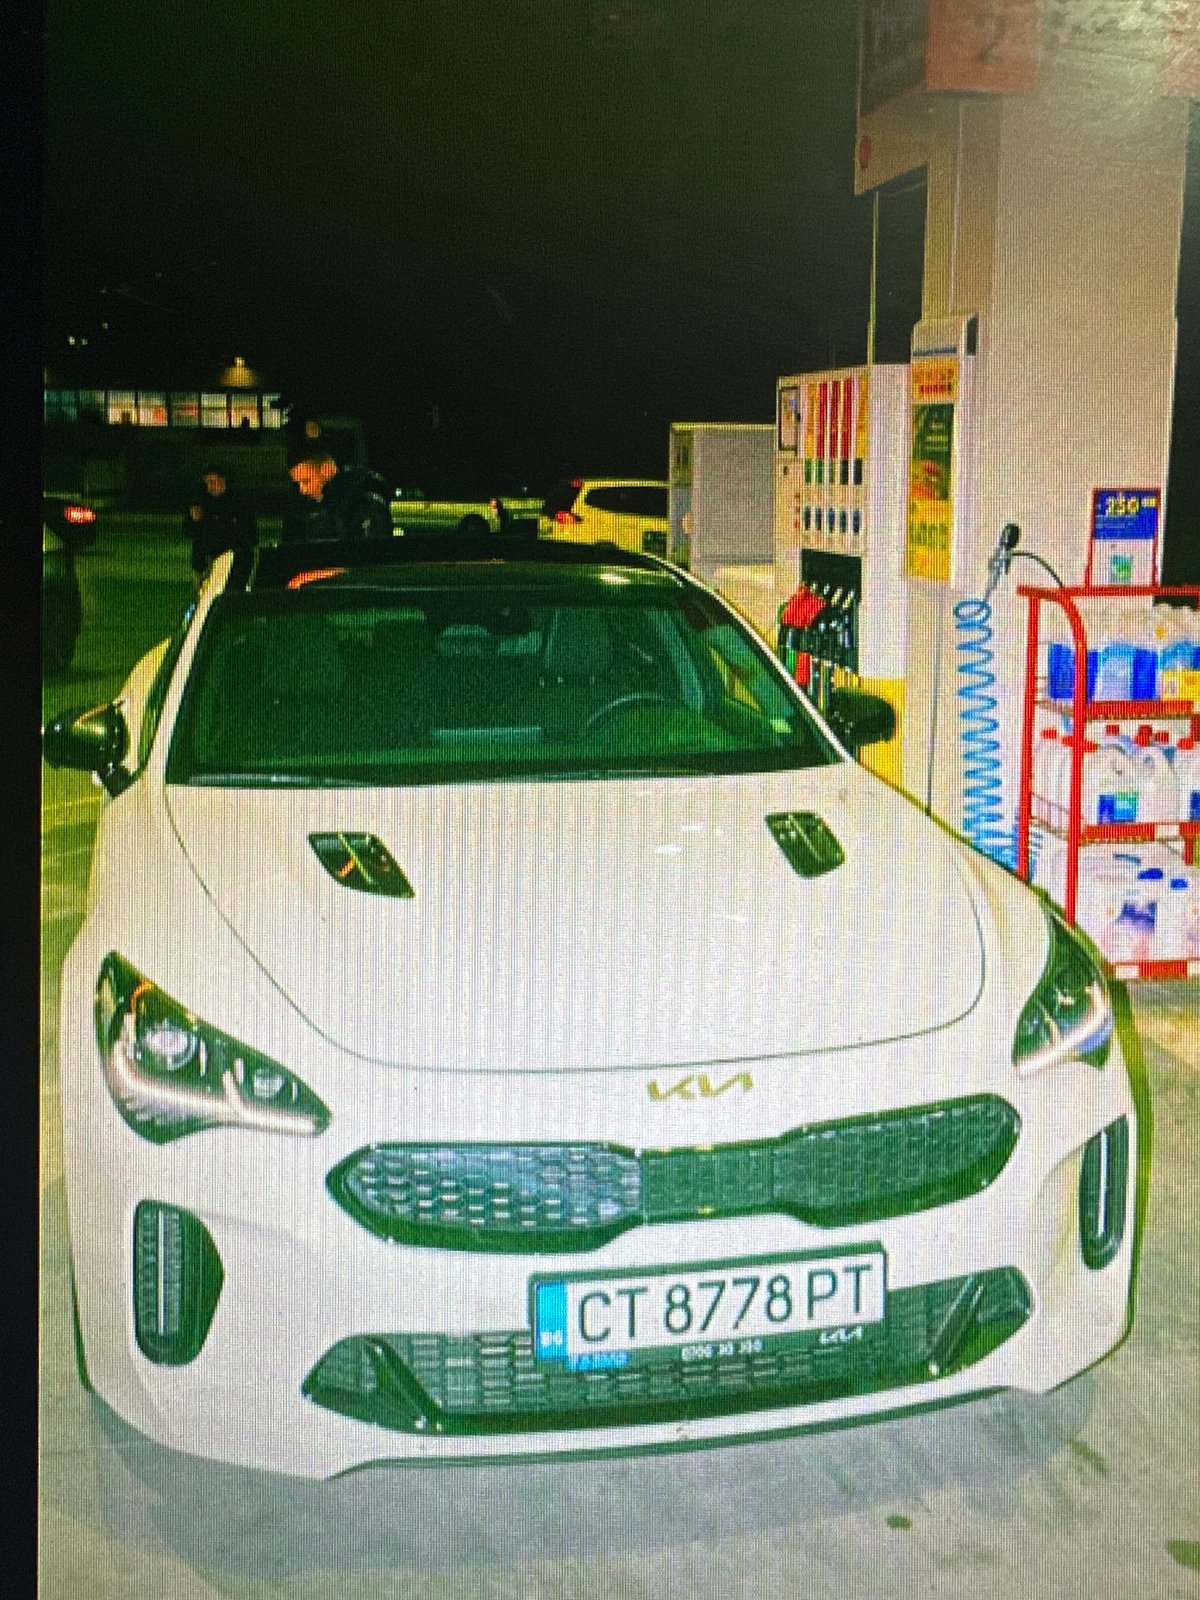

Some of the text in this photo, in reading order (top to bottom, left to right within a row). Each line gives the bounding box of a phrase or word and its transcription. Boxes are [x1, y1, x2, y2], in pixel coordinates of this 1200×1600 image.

[647, 1070, 753, 1101] KIA
[578, 1264, 872, 1344] CT 8778 PT
